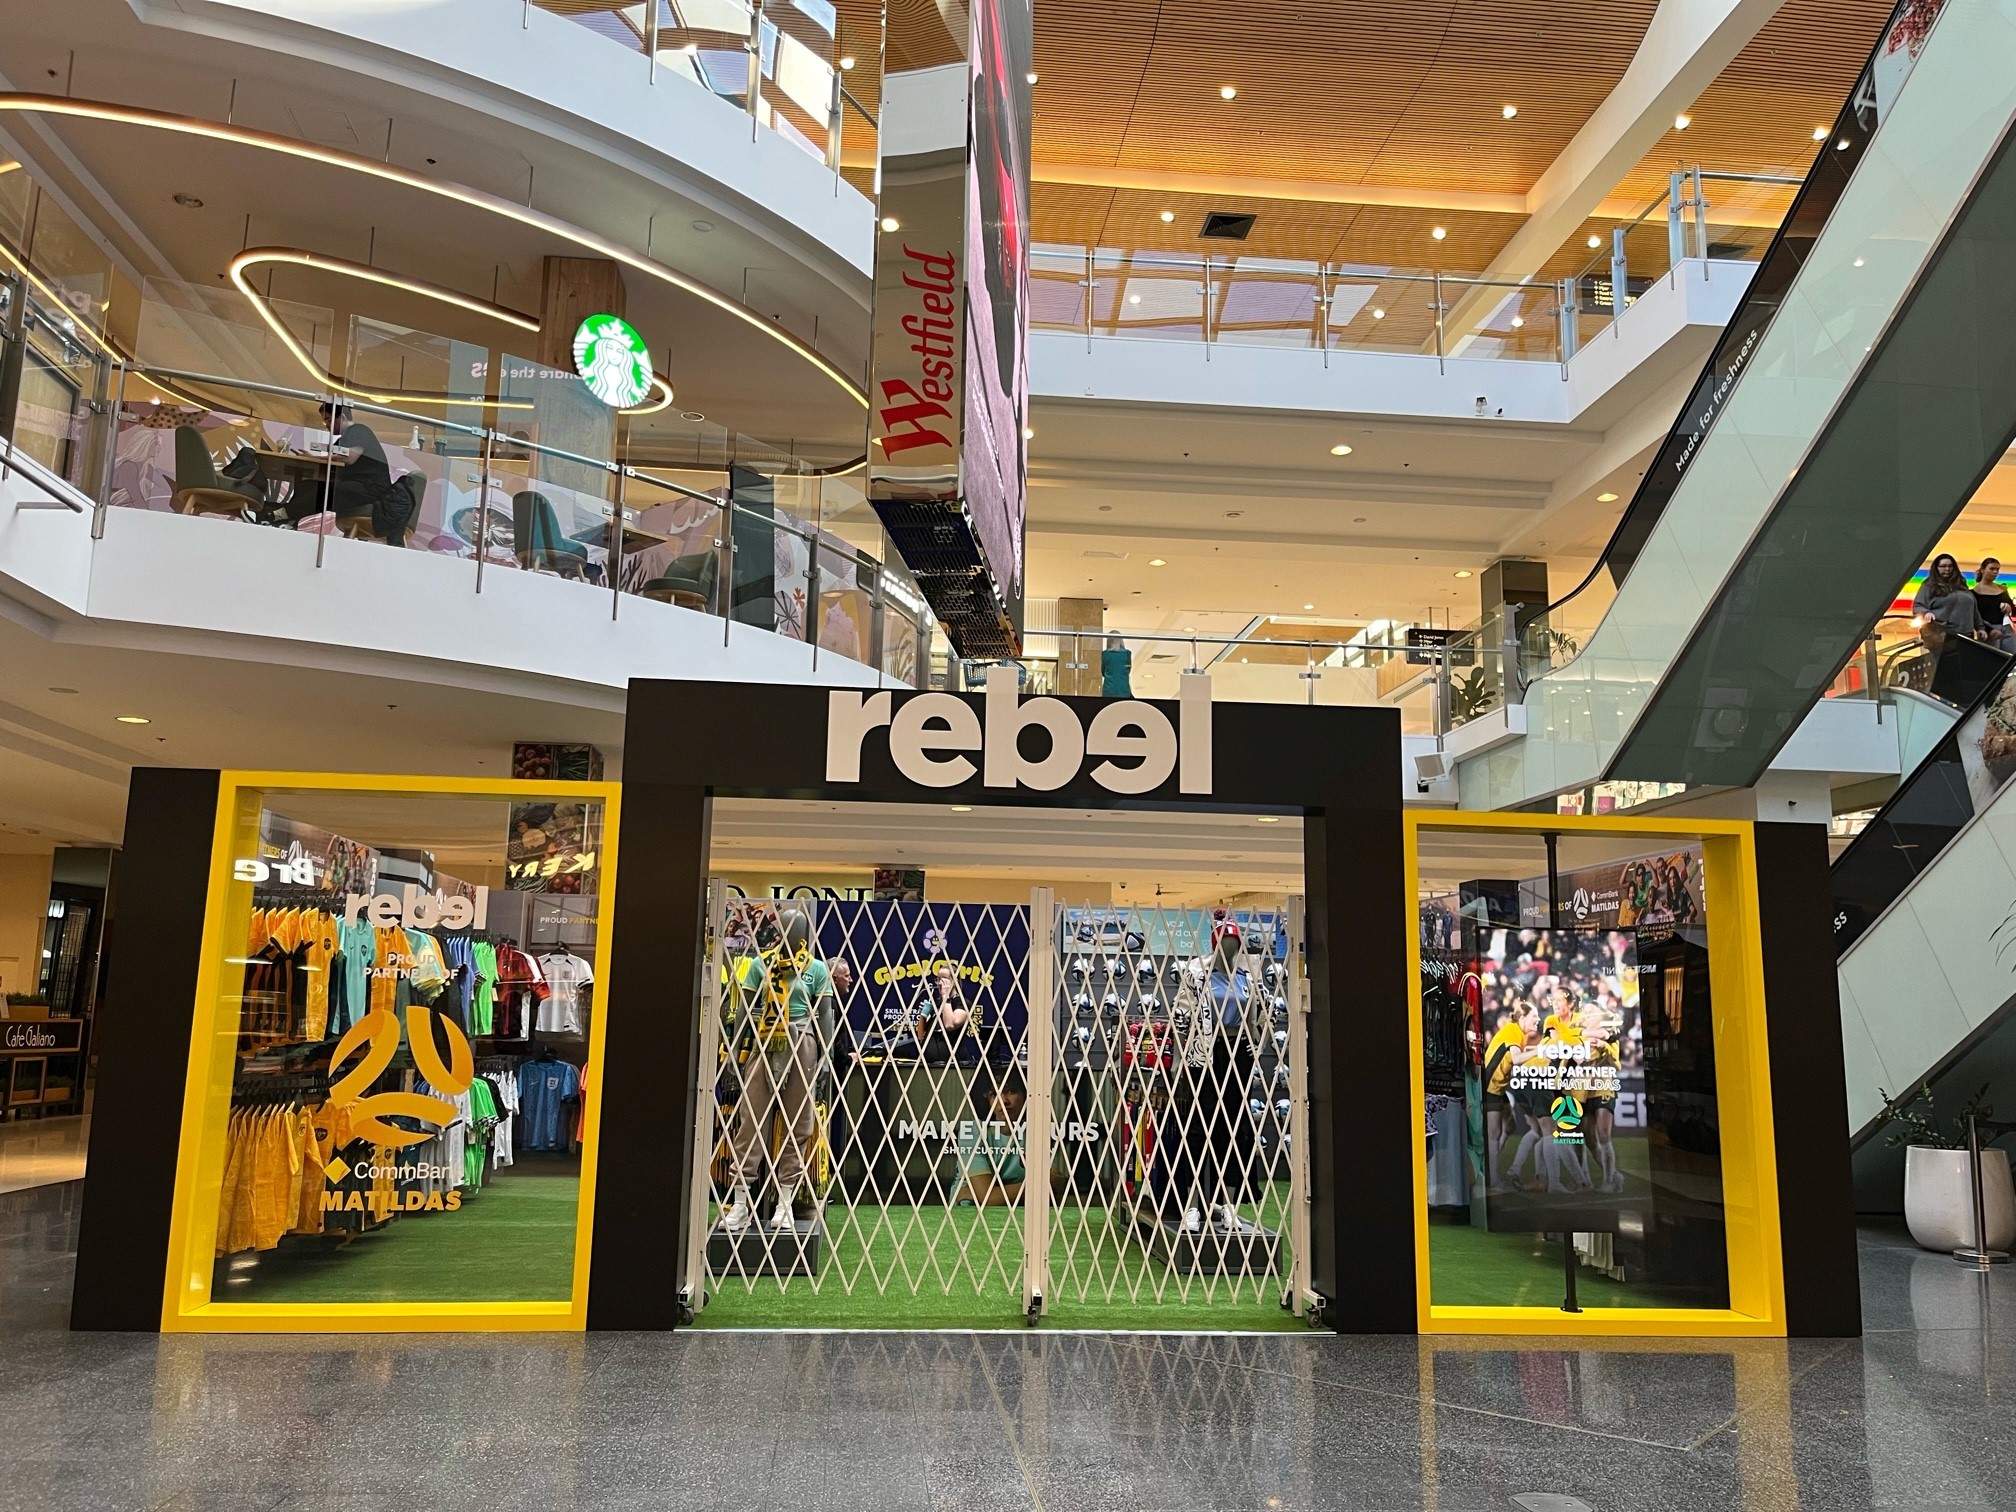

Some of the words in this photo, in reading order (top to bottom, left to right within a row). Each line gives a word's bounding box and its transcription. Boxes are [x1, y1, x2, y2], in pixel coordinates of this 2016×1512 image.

[880, 243, 956, 462] Westfield
[1675, 431, 1700, 472] Made
[1699, 404, 1714, 430] for
[1713, 329, 1758, 405] freshness
[826, 666, 1213, 795] rebel
[345, 883, 489, 930] rebel
[1523, 906, 1541, 917] PROUD
[1564, 901, 1572, 910] OF
[1591, 900, 1620, 913] MATILDAS
[540, 916, 568, 924] PROUD
[388, 953, 437, 966] PROUD
[6, 1025, 25, 1048] Cafe
[1537, 1041, 1592, 1060] rebel
[1512, 1065, 1557, 1078] PROUD
[1558, 1066, 1617, 1078] PARTNER
[1510, 1079, 1528, 1090] OF
[1529, 1079, 1556, 1090] THE
[1558, 1079, 1621, 1091] MATILDAS
[898, 1119, 974, 1140] MAKE
[982, 1120, 1006, 1141] IT
[1012, 1120, 1100, 1142] YURS
[318, 1190, 462, 1212] MATILDAS
